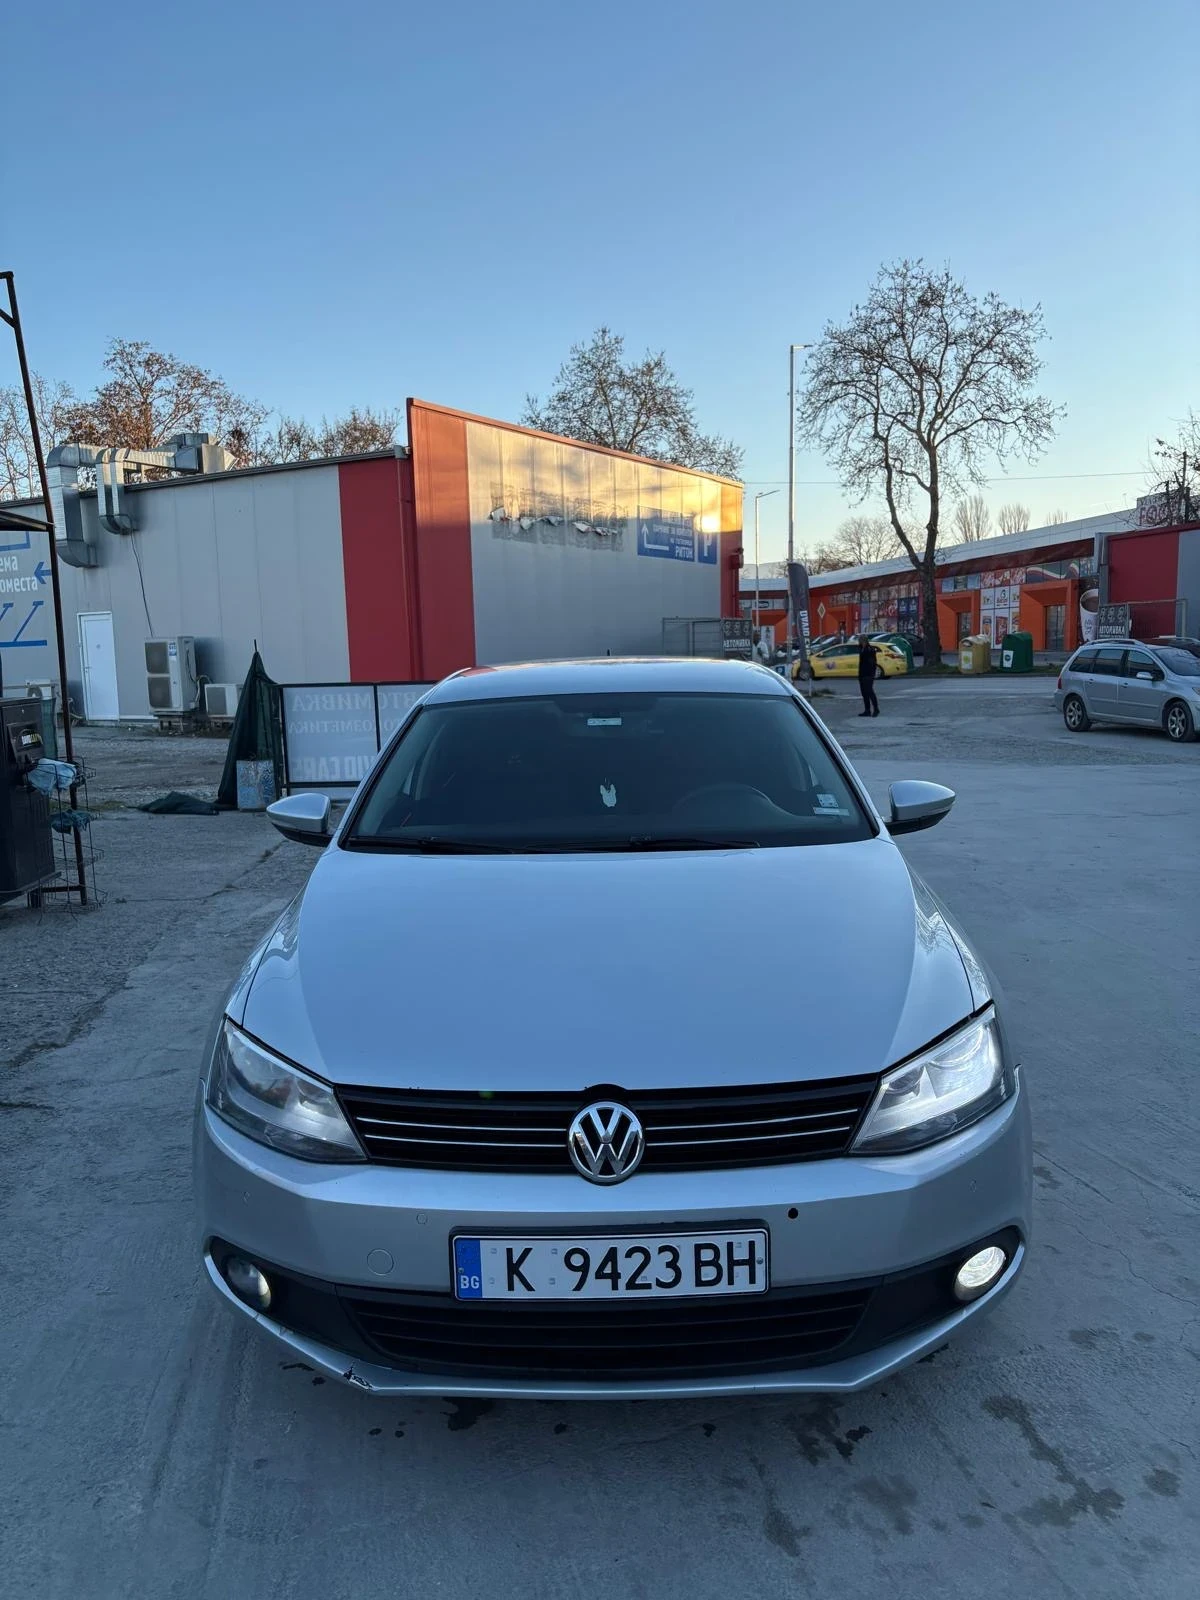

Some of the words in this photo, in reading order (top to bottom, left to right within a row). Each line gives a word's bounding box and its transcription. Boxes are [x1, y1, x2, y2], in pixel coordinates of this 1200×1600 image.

[460, 1275, 480, 1289] BG
[506, 1247, 536, 1292] K
[563, 1244, 682, 1292] 9423
[694, 1240, 756, 1288] BH
